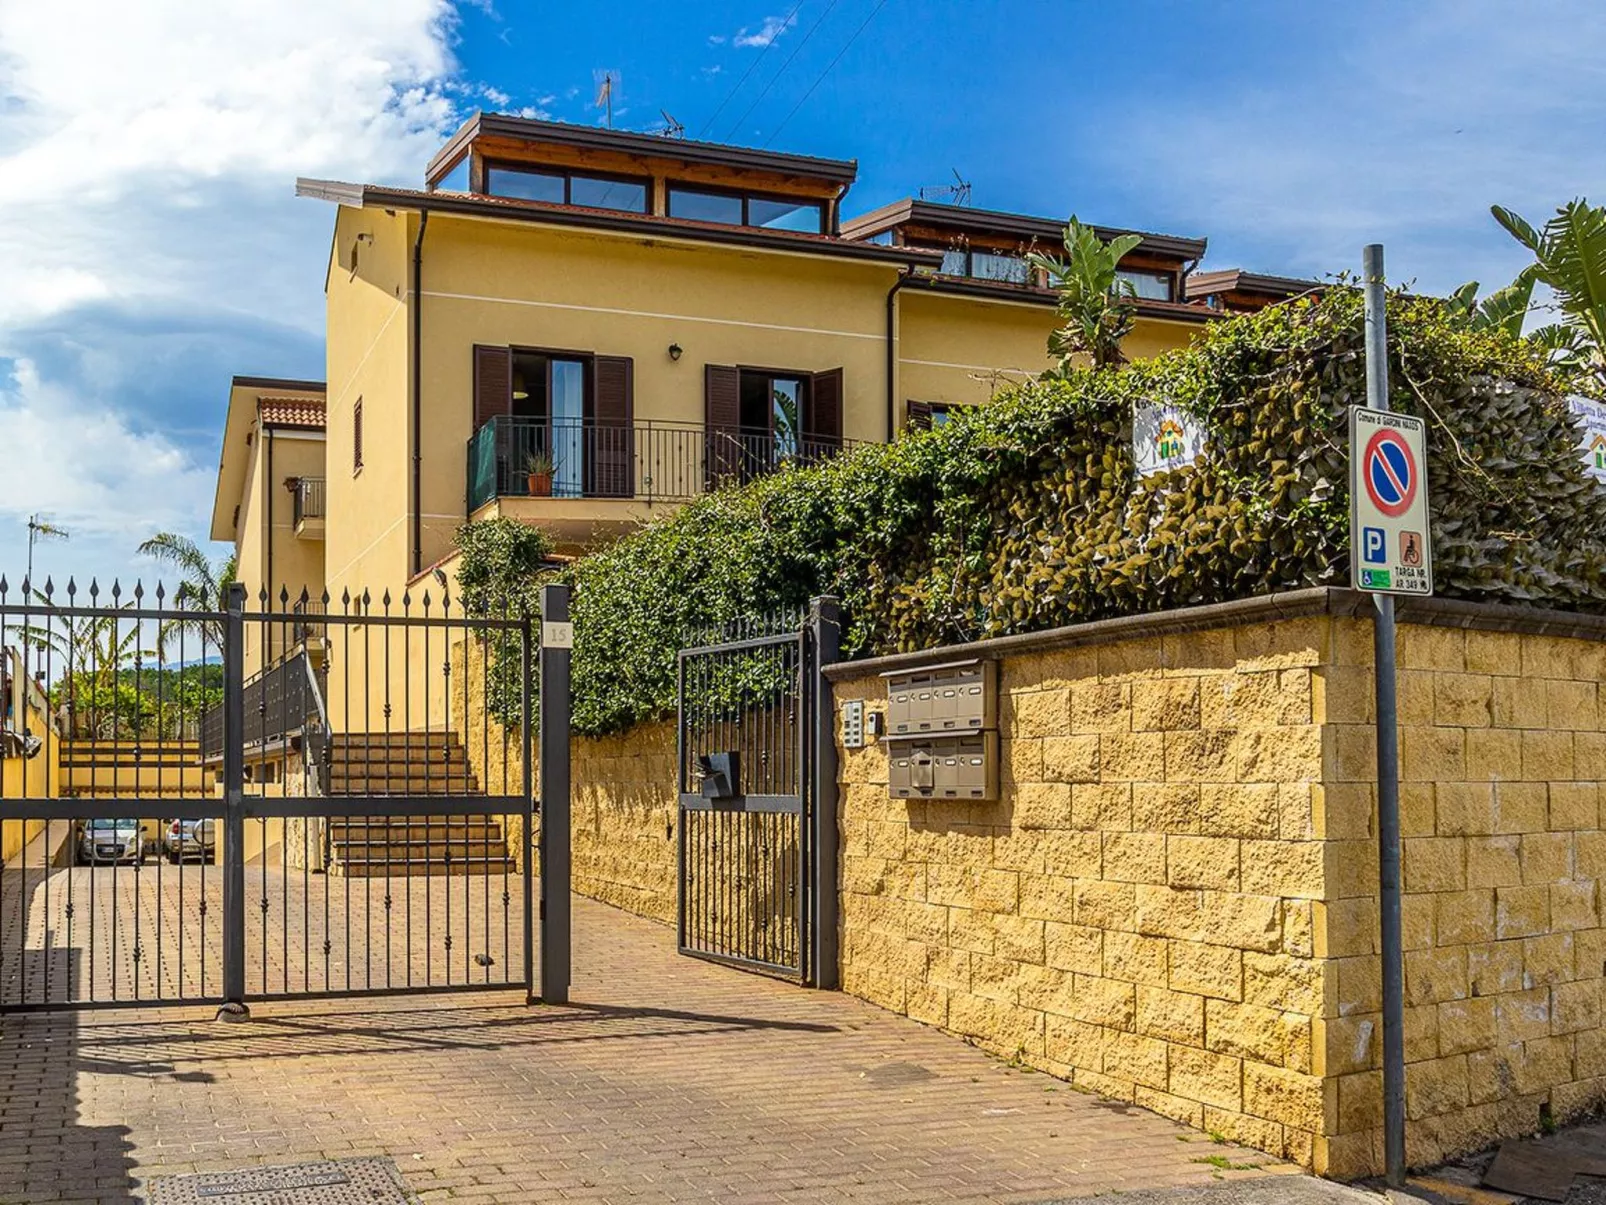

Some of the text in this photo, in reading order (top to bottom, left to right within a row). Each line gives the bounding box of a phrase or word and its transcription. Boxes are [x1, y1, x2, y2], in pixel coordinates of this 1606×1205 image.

[1367, 530, 1382, 560] P
[1395, 566, 1416, 577] TARGA
[551, 628, 567, 642] 15
